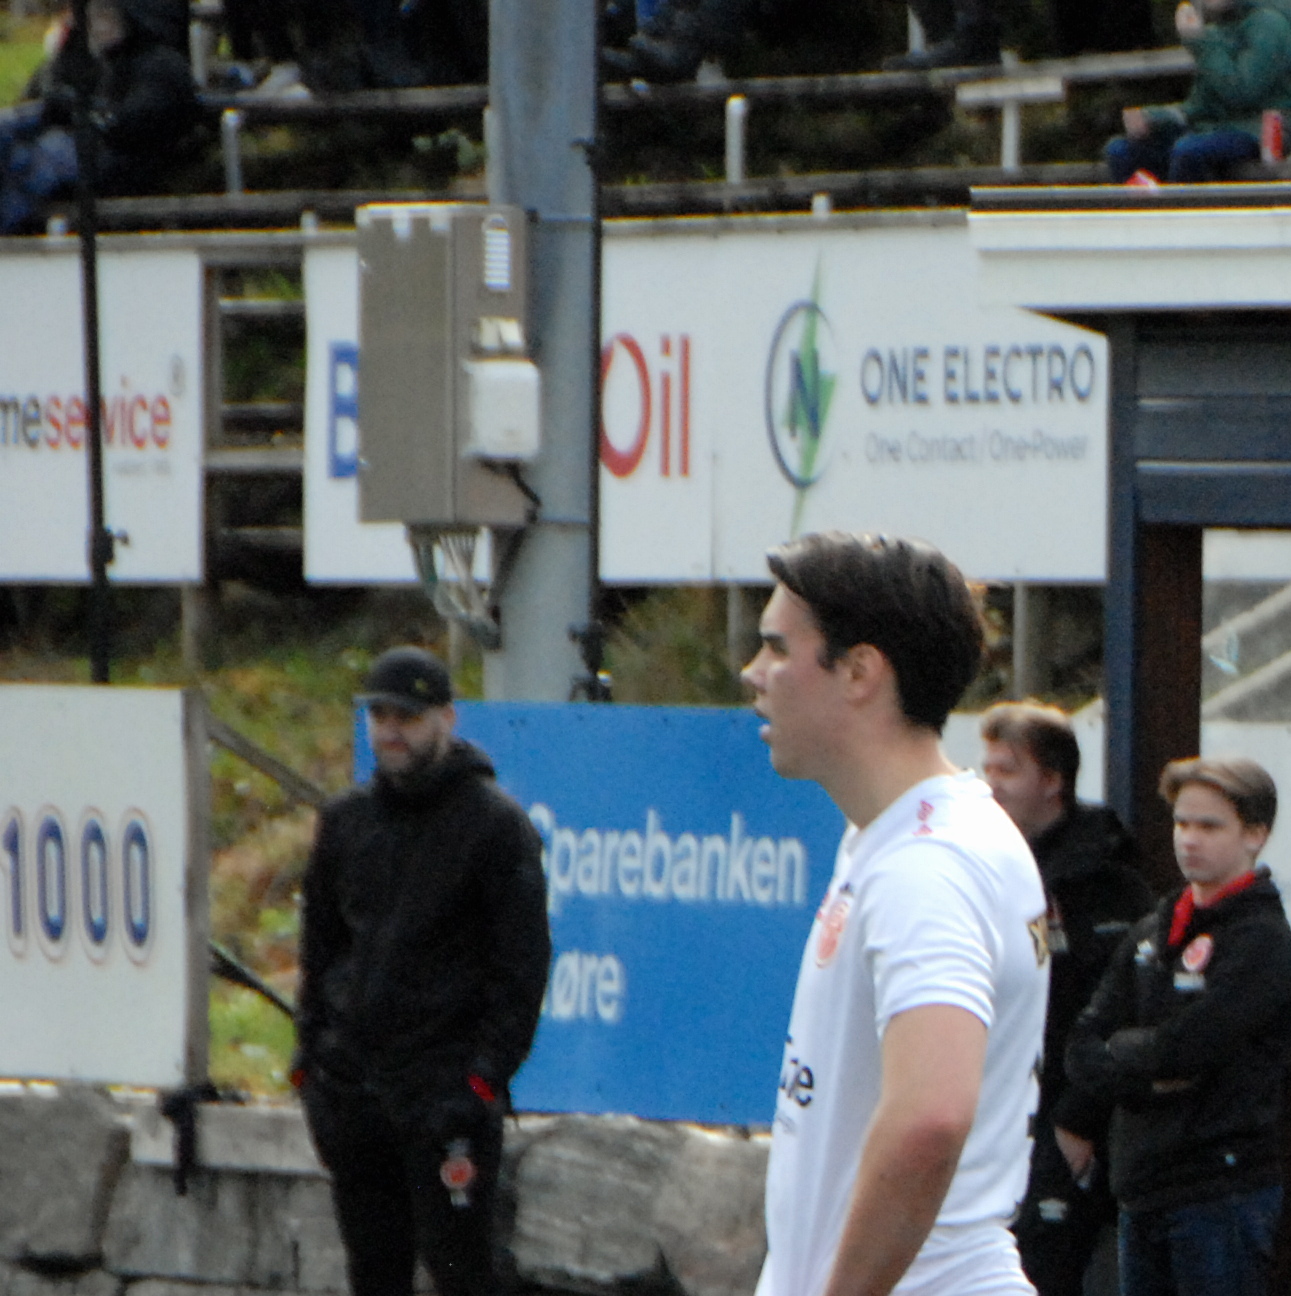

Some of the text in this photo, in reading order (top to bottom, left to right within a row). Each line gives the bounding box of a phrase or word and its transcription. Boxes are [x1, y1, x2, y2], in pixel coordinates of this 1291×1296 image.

[601, 332, 691, 478] Oil
[861, 343, 1095, 404] ONE ELECTRO
[2, 812, 150, 948] 1000
[543, 948, 624, 1022] øre
